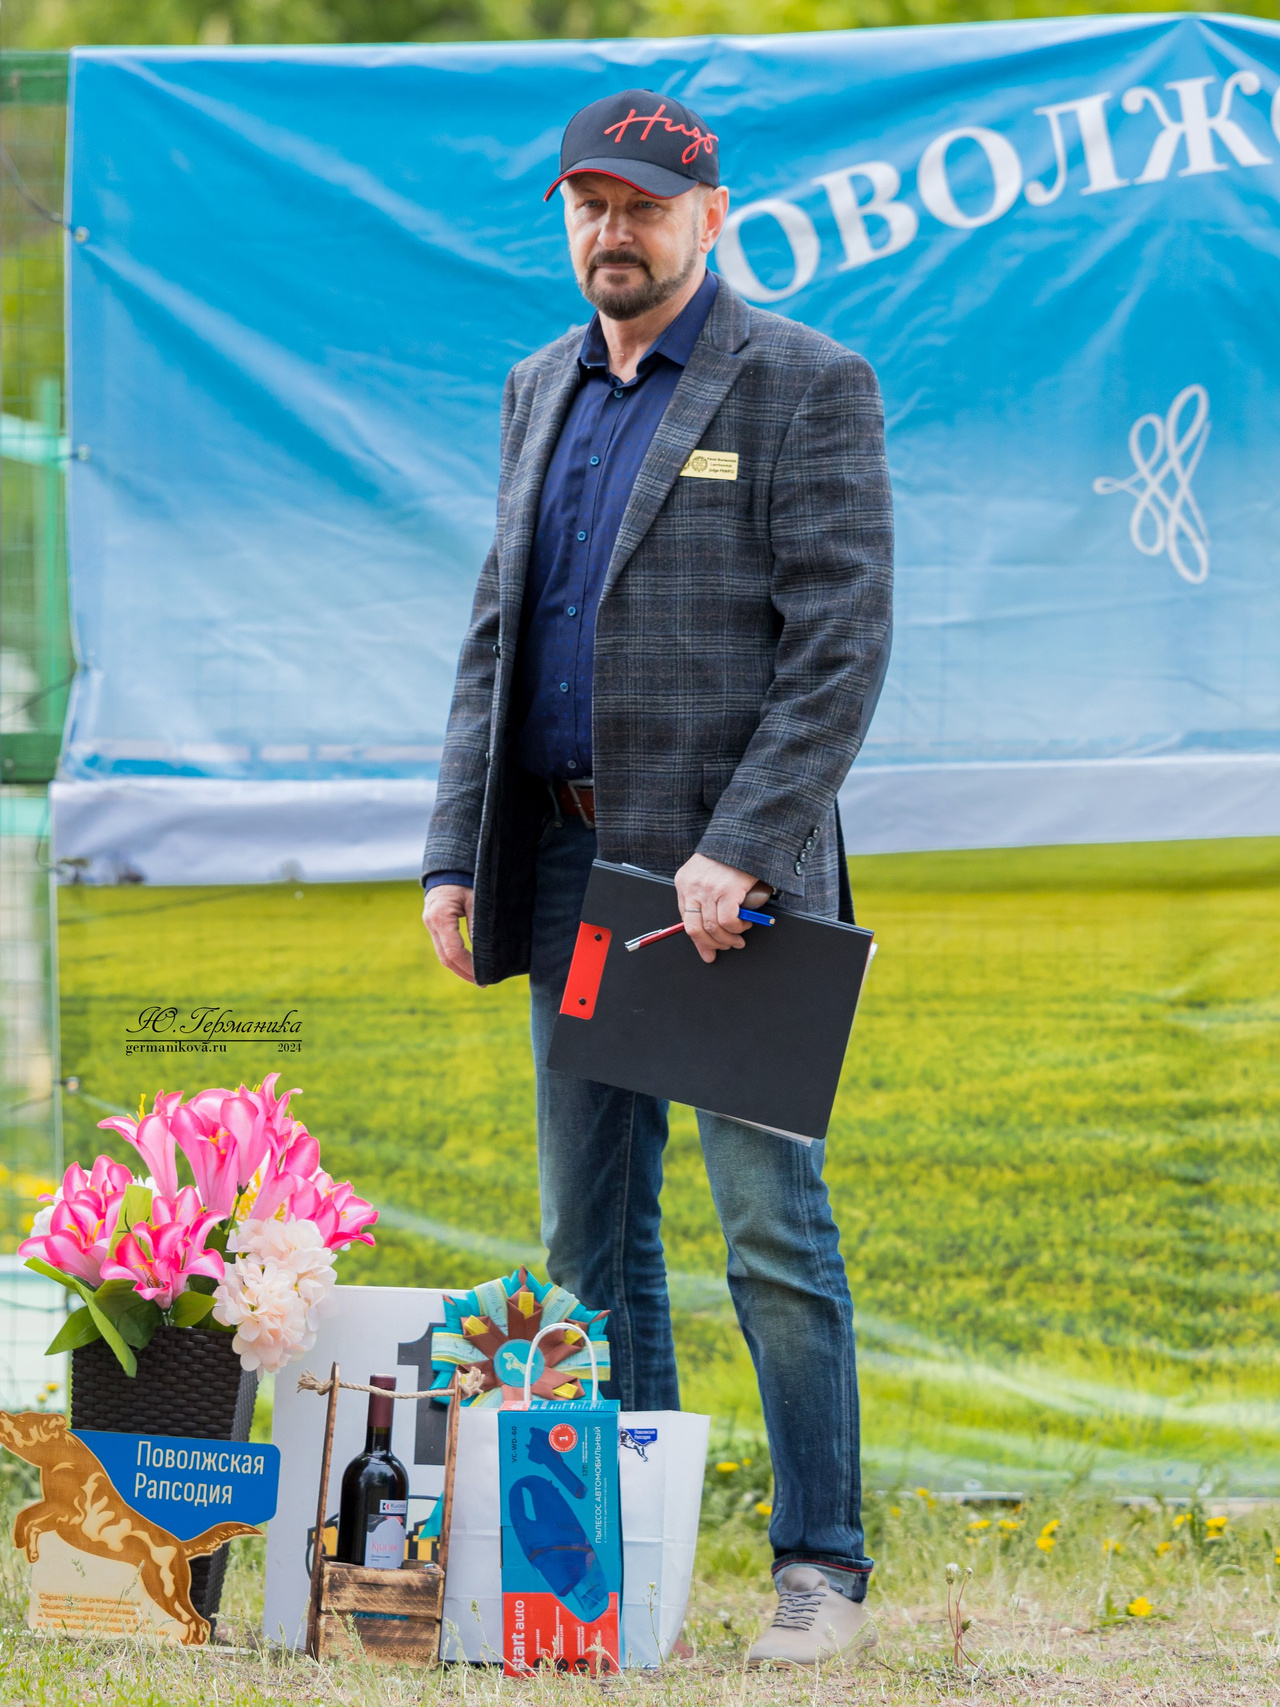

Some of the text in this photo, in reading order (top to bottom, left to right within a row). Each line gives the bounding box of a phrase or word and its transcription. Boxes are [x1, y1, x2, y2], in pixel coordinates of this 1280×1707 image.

[604, 104, 719, 164] Hugo
[715, 70, 1280, 302] ОВОЛЖ
[137, 1440, 265, 1475] Поволжская
[134, 1472, 233, 1508] Рапсодия
[594, 1426, 602, 1544] ПЫЛЕСОС АВТОМОБИЛЬНЫЙ
[514, 1600, 525, 1630] auto
